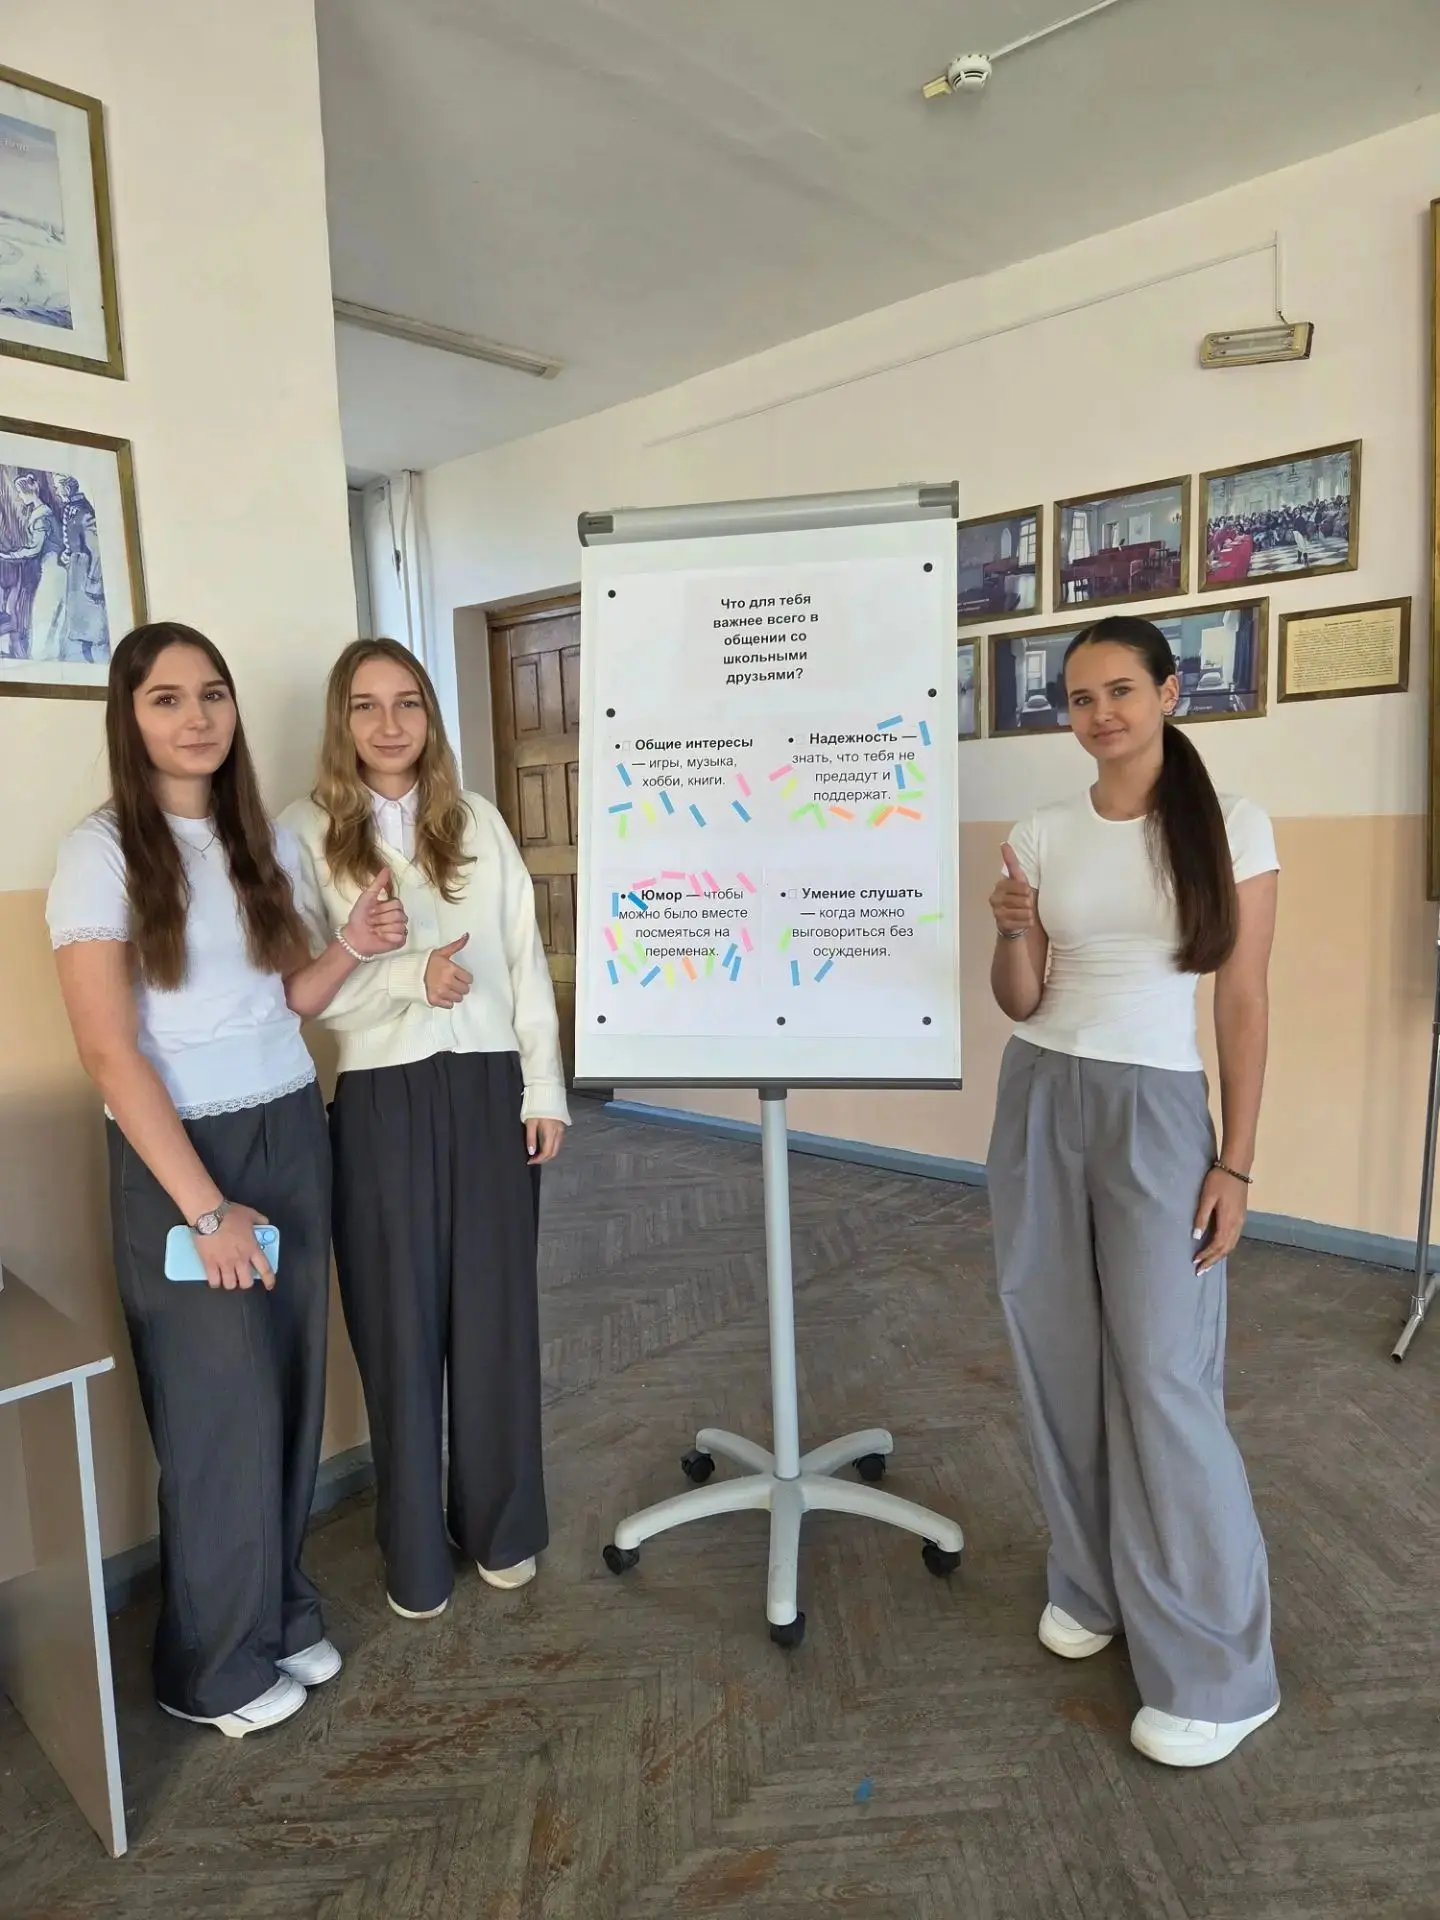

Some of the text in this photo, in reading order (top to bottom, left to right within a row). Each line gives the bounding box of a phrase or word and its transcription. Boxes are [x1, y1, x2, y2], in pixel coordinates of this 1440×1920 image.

[720, 594, 812, 610] Что для тебя
[712, 613, 819, 629] важнее всего в
[723, 632, 808, 647] общении со
[723, 651, 808, 666] школьными
[725, 667, 804, 685] друзьями?
[634, 737, 754, 752] Общие интересы
[809, 731, 898, 746] Надежность
[649, 759, 683, 771] игры,
[686, 757, 738, 771] музыка,
[791, 749, 916, 765] знать, что тебя не
[641, 774, 726, 787] хобби, книги.
[814, 770, 891, 785] предадут и
[812, 789, 892, 803] поддержат.
[640, 889, 683, 903] Юмор
[703, 887, 744, 900] чтобы
[801, 887, 924, 902] Умение слушать
[617, 906, 748, 920] можно было вместе
[819, 908, 856, 921] когда
[859, 907, 905, 918] можно
[635, 926, 730, 938] посмеяться на
[792, 924, 914, 940] выговориться без
[644, 947, 719, 960] переменах.
[813, 946, 892, 960] осуждения.
